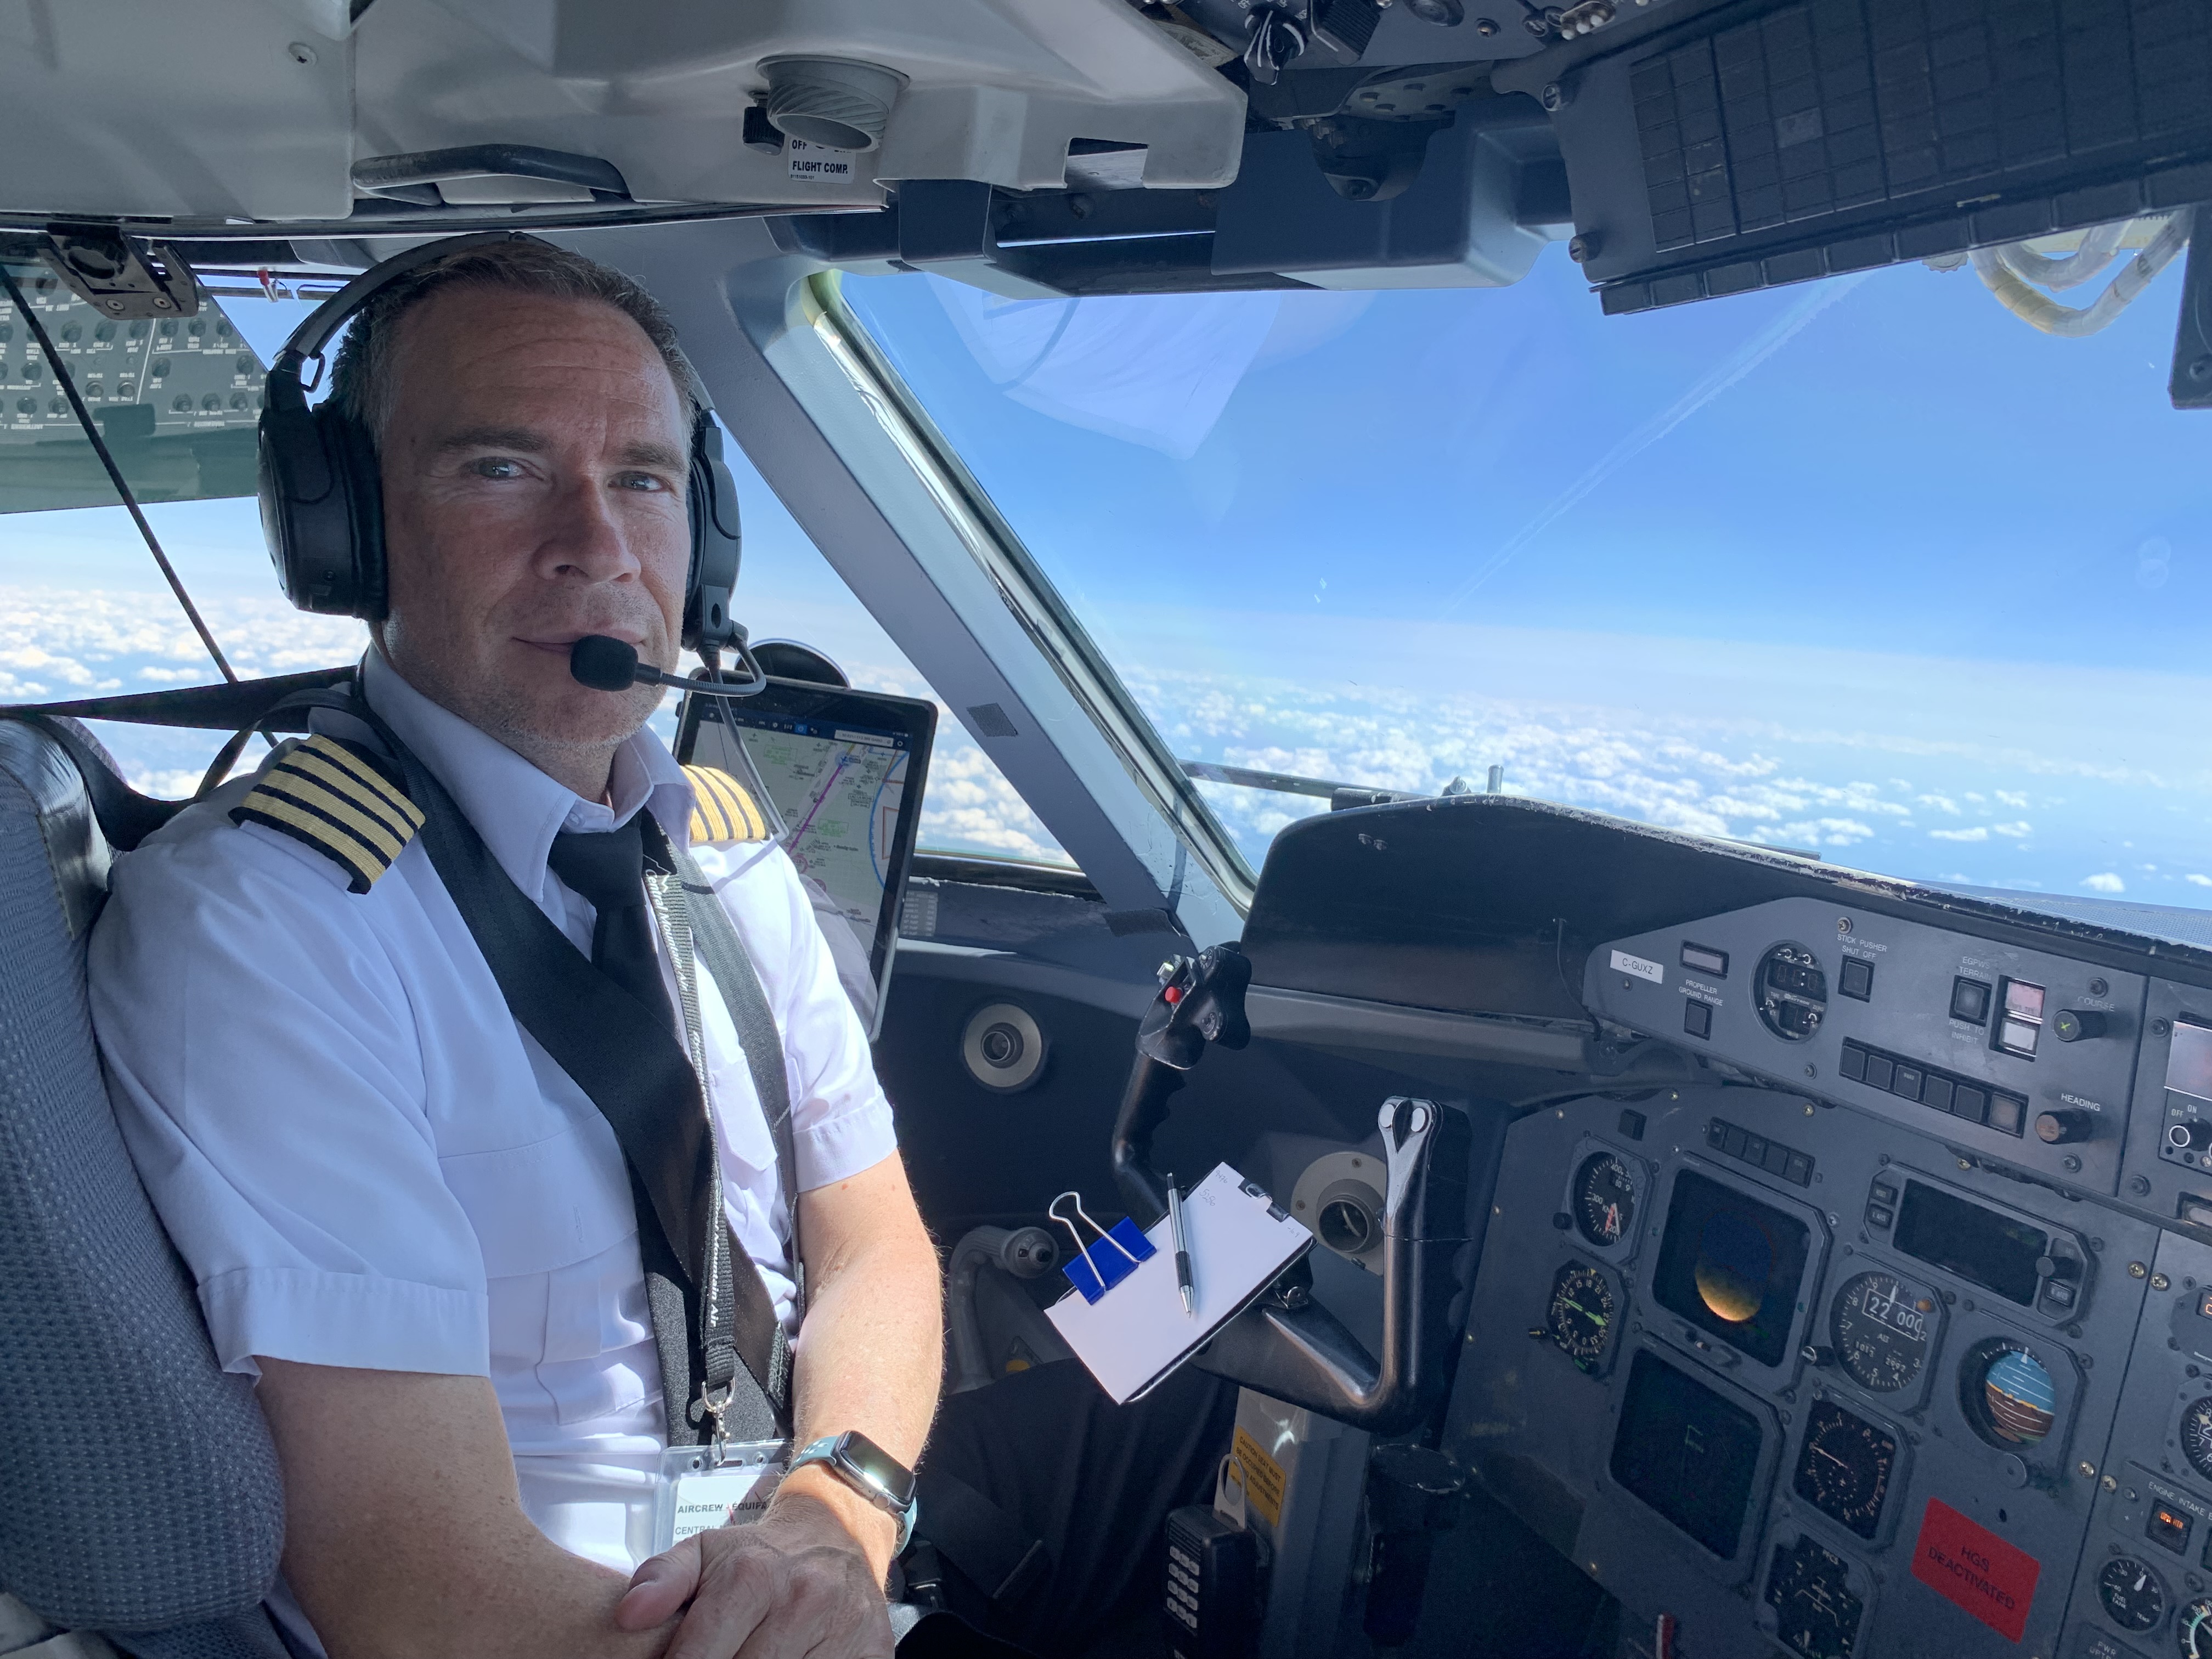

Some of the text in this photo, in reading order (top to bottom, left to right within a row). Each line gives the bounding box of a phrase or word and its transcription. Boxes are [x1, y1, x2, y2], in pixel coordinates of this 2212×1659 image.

[792, 160, 848, 174] FLIGHT COMP.
[645, 869, 689, 992] Central Mountain Air
[1837, 934, 1887, 952] STICK PUSHER
[1842, 945, 1877, 960] SHUT OFF
[1622, 957, 1653, 974] C-GUXZ
[1962, 957, 1990, 969] EGPWS
[1959, 966, 1992, 981] TERRAIN
[1685, 979, 1717, 995] PROPELLER
[1678, 986, 1724, 1007] GROUND RANGE
[2078, 996, 2115, 1012] COURSE
[1949, 1019, 1984, 1035] PUSH TO
[1952, 1031, 1978, 1045] INHIBIT
[2061, 1093, 2101, 1112] HEADING
[2187, 1104, 2197, 1114] ON
[2171, 1108, 2183, 1118] OFF
[710, 1304, 720, 1328] Air
[1869, 1296, 1891, 1319] 22
[1239, 1436, 1258, 1459] CAUTION
[1258, 1455, 1269, 1469] SEAT
[1269, 1466, 1282, 1483] MUST
[1242, 1453, 1263, 1479] OCCUPIED
[1249, 1475, 1279, 1511] ADJUSTMENTS
[2148, 1481, 2175, 1500] ENGINE
[2178, 1497, 2206, 1516] INTAKE
[678, 1503, 723, 1514] AIRCREW
[1961, 1545, 1990, 1572] HGS
[1928, 1546, 2016, 1610] DEACTIVATED
[2137, 1612, 2150, 1623] TEMP
